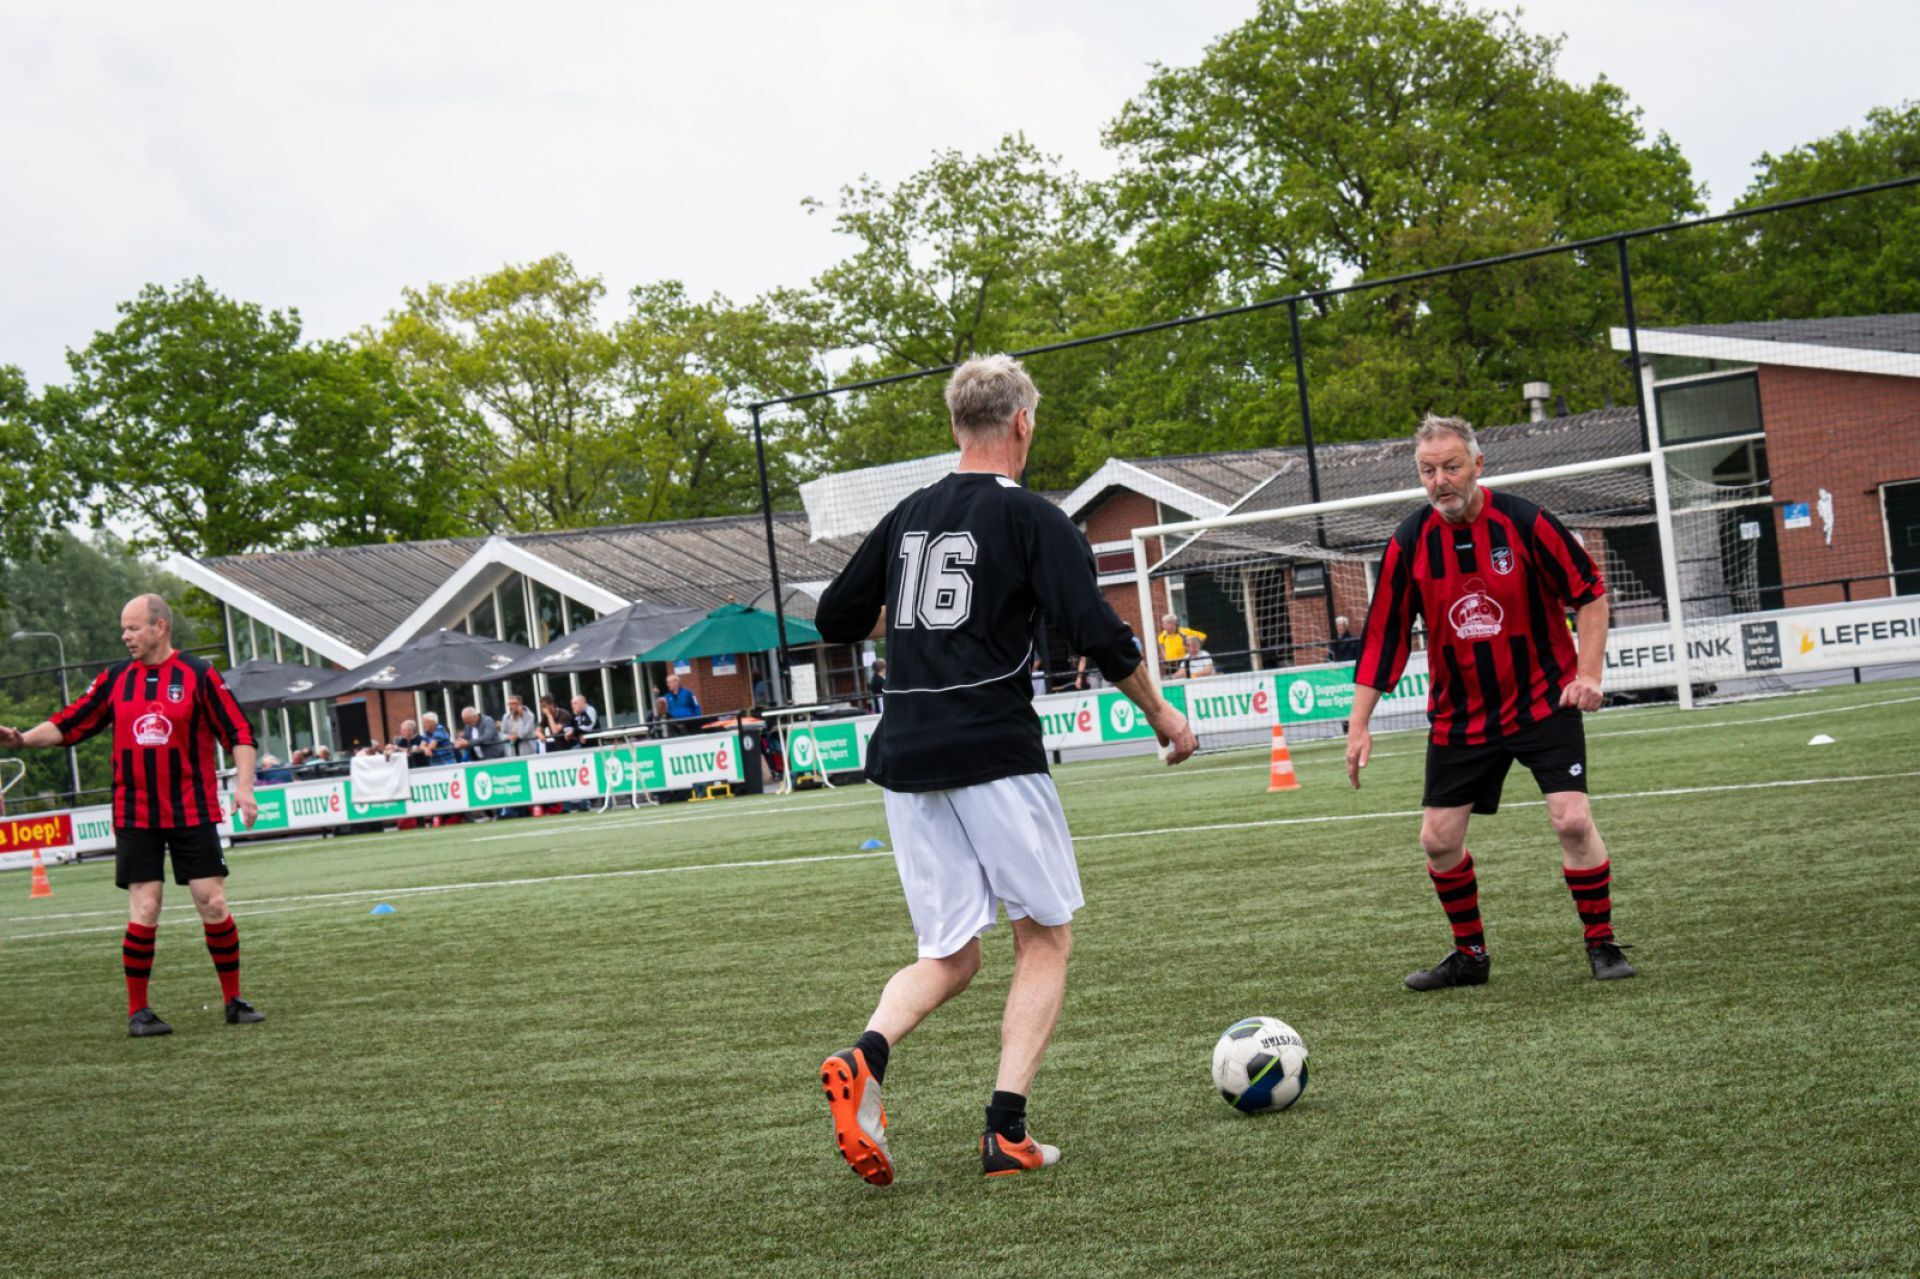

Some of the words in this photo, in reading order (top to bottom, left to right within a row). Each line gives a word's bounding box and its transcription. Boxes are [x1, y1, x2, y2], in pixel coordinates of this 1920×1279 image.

[895, 530, 978, 630] 16
[1820, 617, 1920, 646] LEFERI
[1194, 681, 1269, 720] univé
[1039, 701, 1092, 735] nivé
[535, 757, 590, 790] univé
[670, 742, 728, 776] univé
[292, 786, 340, 817] univé
[410, 772, 461, 804] univé
[11, 816, 61, 846] Joep!
[77, 820, 115, 841] univ
